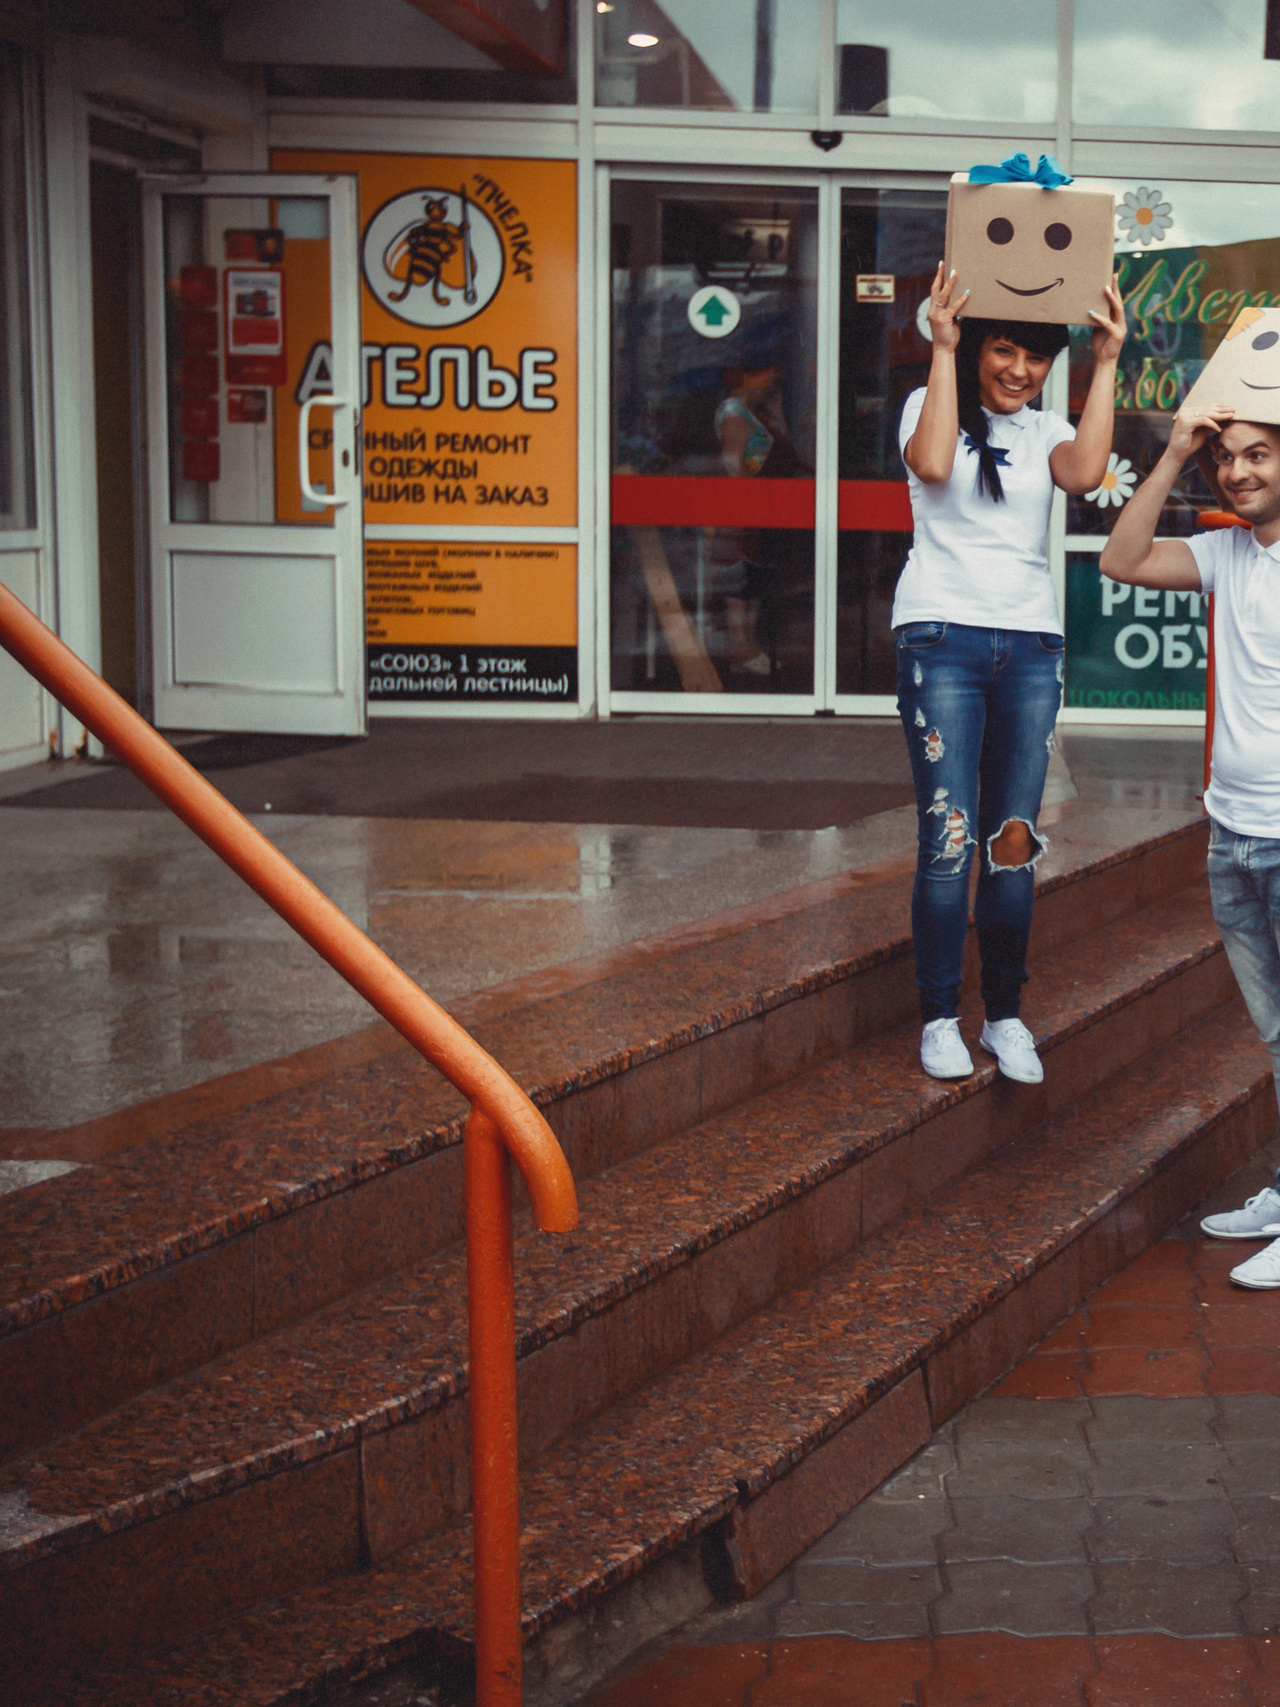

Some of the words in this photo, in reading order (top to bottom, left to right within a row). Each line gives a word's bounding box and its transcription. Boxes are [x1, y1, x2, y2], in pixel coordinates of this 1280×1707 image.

[308, 427, 427, 452] СРНЫЙ
[434, 432, 531, 455] РЕМОНТ
[368, 456, 478, 480] ОДЕЖДЫ
[434, 484, 468, 504] НА
[474, 485, 549, 506] ЗАКАЗ
[1099, 573, 1209, 618] РЕМ
[459, 655, 470, 673] 1
[477, 657, 528, 674] этаж
[369, 674, 457, 692] дальней
[463, 674, 569, 695] лестницы)
